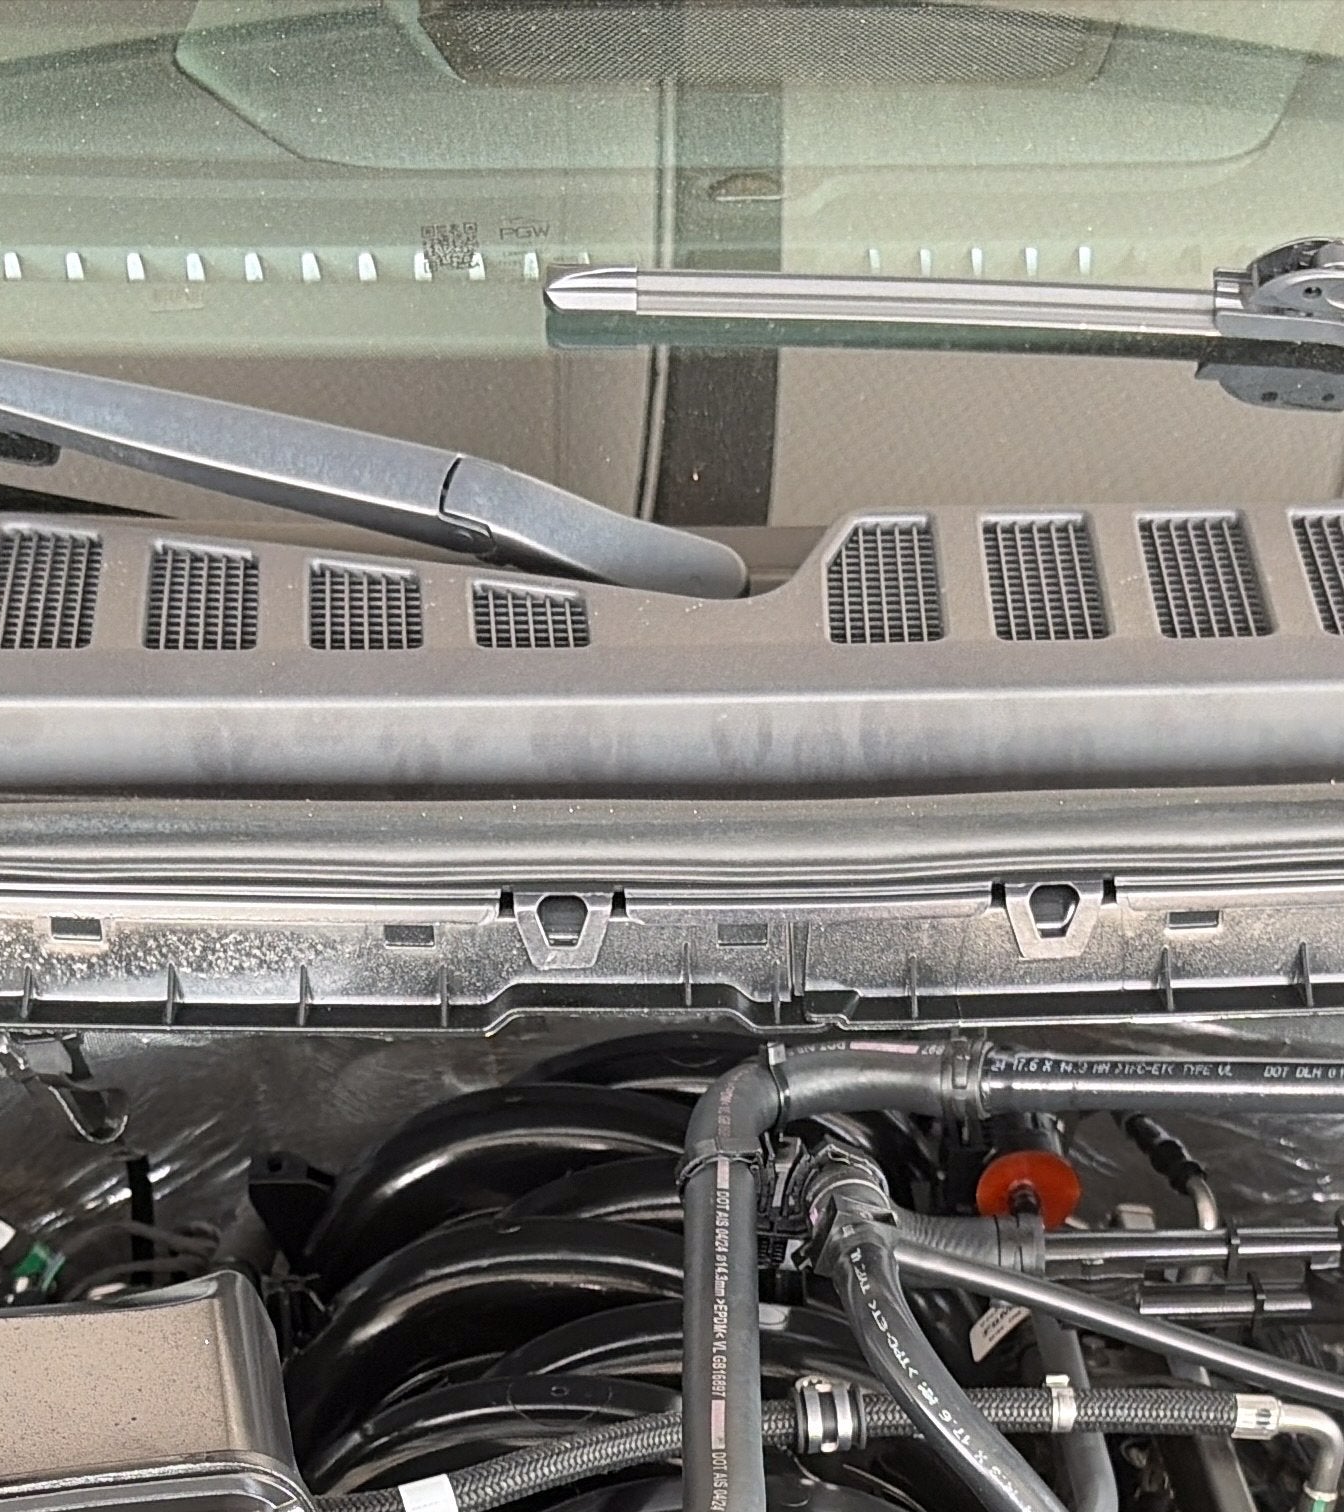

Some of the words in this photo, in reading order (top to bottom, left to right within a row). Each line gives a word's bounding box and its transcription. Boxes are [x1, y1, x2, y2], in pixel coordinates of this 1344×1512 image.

[499, 224, 550, 240] PGW
[1042, 1061, 1053, 1073] X
[1264, 1065, 1289, 1078] DOT
[716, 1190, 730, 1211] DOT
[716, 1211, 730, 1229] AIS
[715, 1228, 729, 1252] 04/24
[713, 1298, 728, 1339] >EPDM<
[712, 1339, 727, 1355] VL
[868, 1299, 920, 1379] >TPC-ET<
[711, 1356, 727, 1398] GB16897
[711, 1452, 727, 1472] DOT
[713, 1472, 728, 1489] AIS
